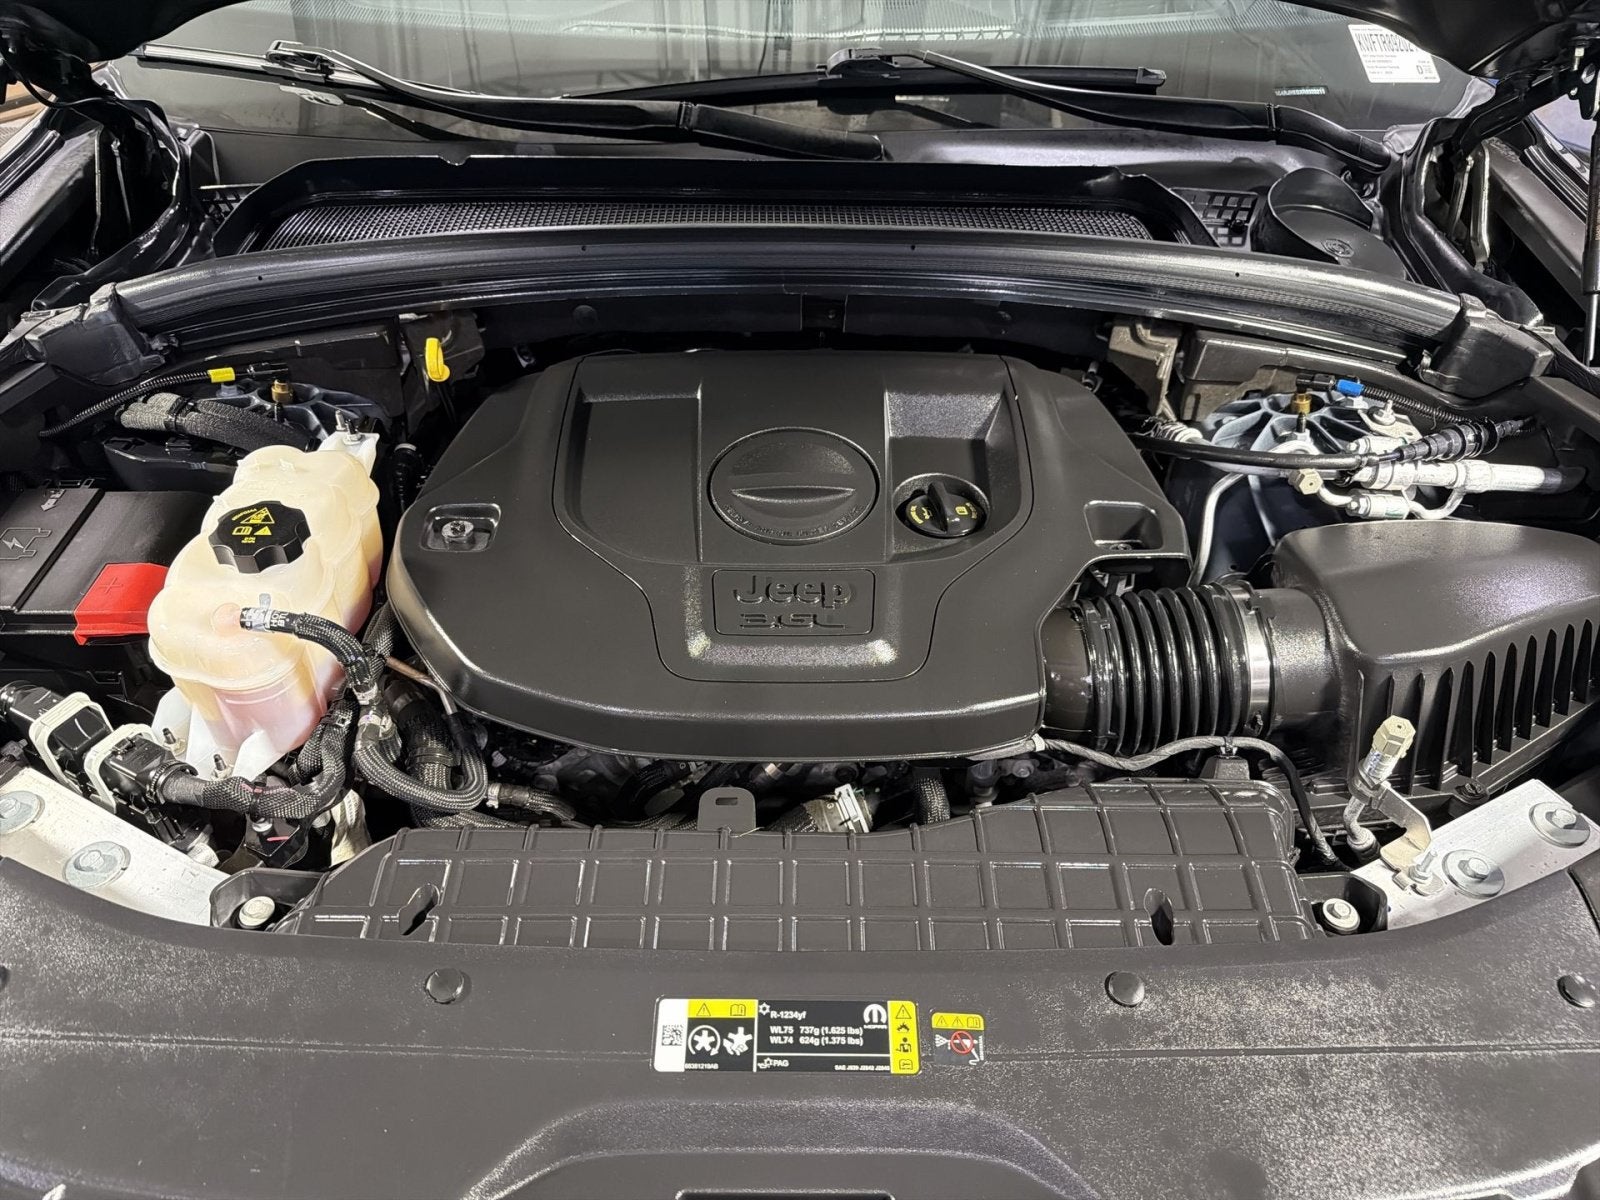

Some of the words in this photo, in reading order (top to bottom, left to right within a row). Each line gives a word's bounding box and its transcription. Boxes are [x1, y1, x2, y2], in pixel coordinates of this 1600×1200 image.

[733, 575, 852, 609] Jeep
[770, 1010, 807, 1021] R-1234yf
[769, 1025, 794, 1034] WL75
[799, 1026, 820, 1036] 737g
[821, 1026, 846, 1036] (1.625
[847, 1026, 863, 1036] lbs)
[769, 1035, 794, 1044] WL74
[799, 1036, 820, 1046] 624g
[821, 1036, 846, 1046] (1.375
[847, 1036, 863, 1046] lbs)
[773, 1059, 790, 1067] PAG
